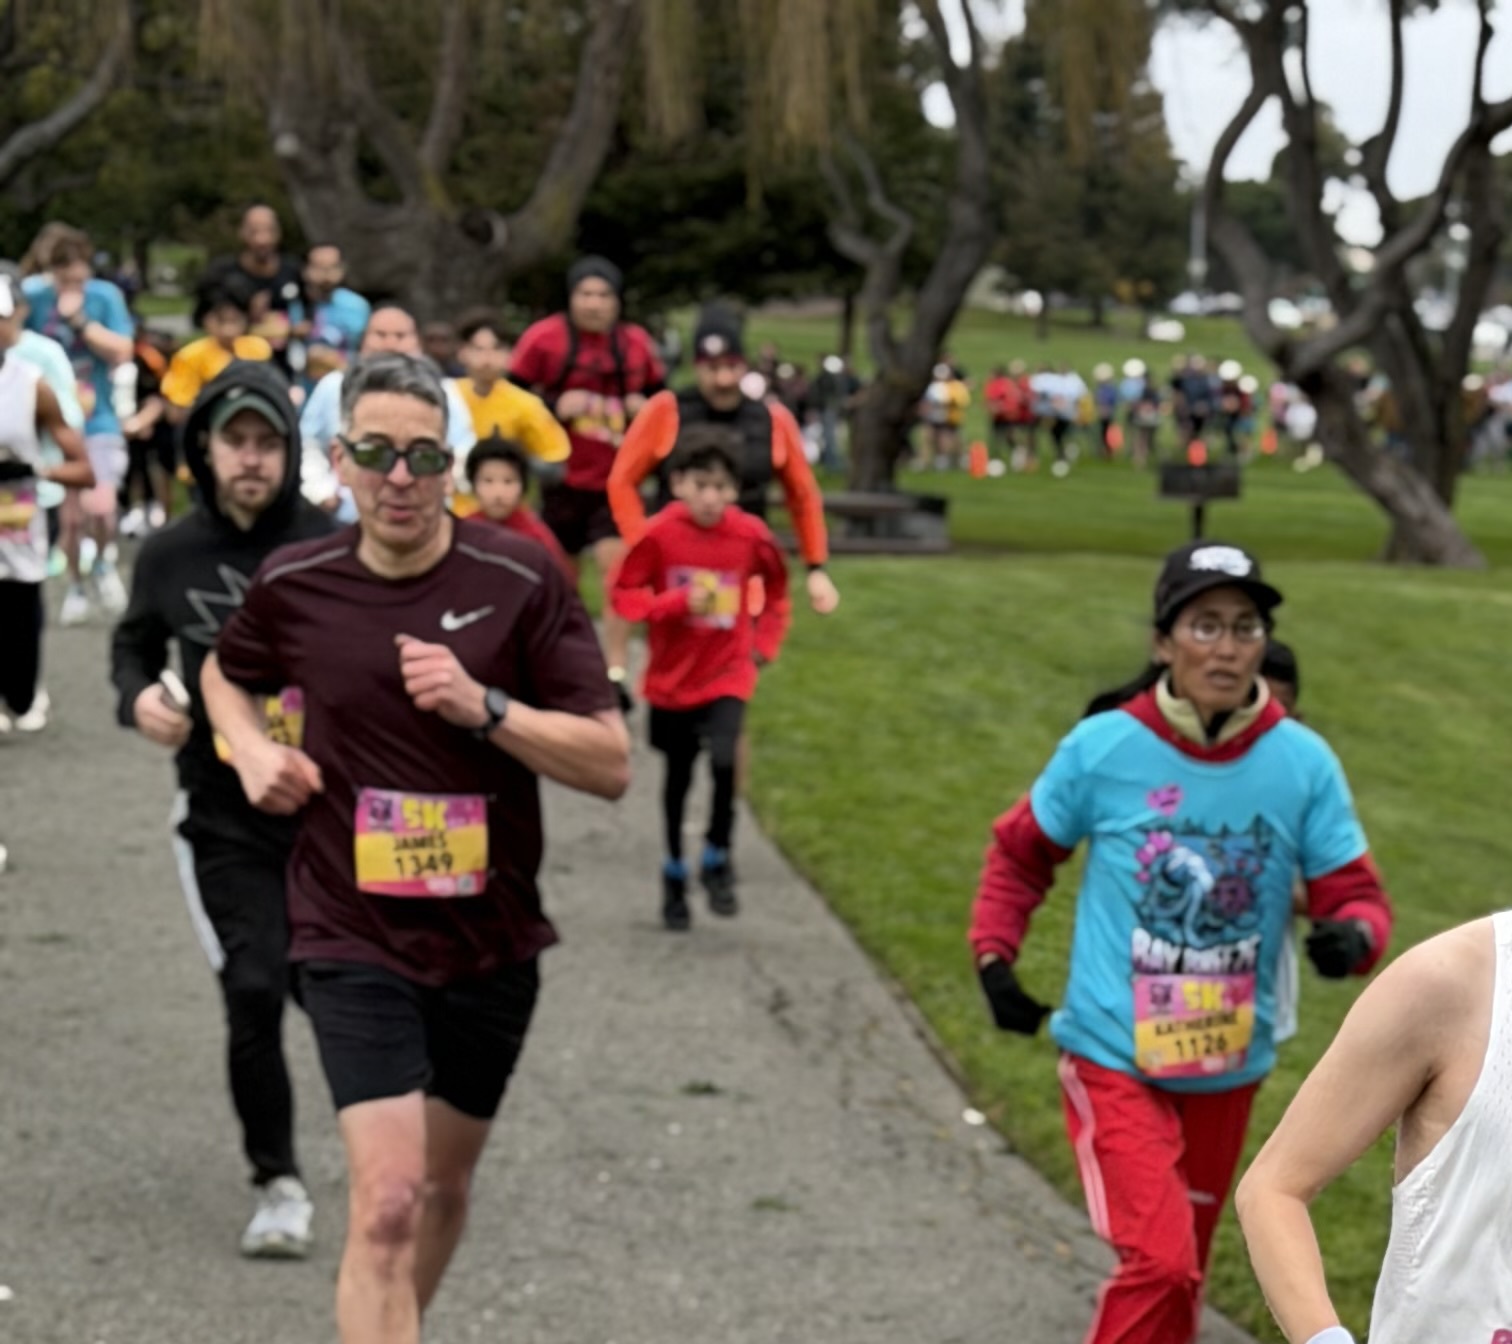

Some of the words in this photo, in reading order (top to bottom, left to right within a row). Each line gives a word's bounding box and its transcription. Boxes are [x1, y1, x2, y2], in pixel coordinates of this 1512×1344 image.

[402, 797, 447, 830] 5K
[394, 831, 447, 851] JAMES
[395, 852, 454, 876] 1349
[1182, 980, 1226, 1011] 5K
[1175, 1032, 1228, 1057] 1126
